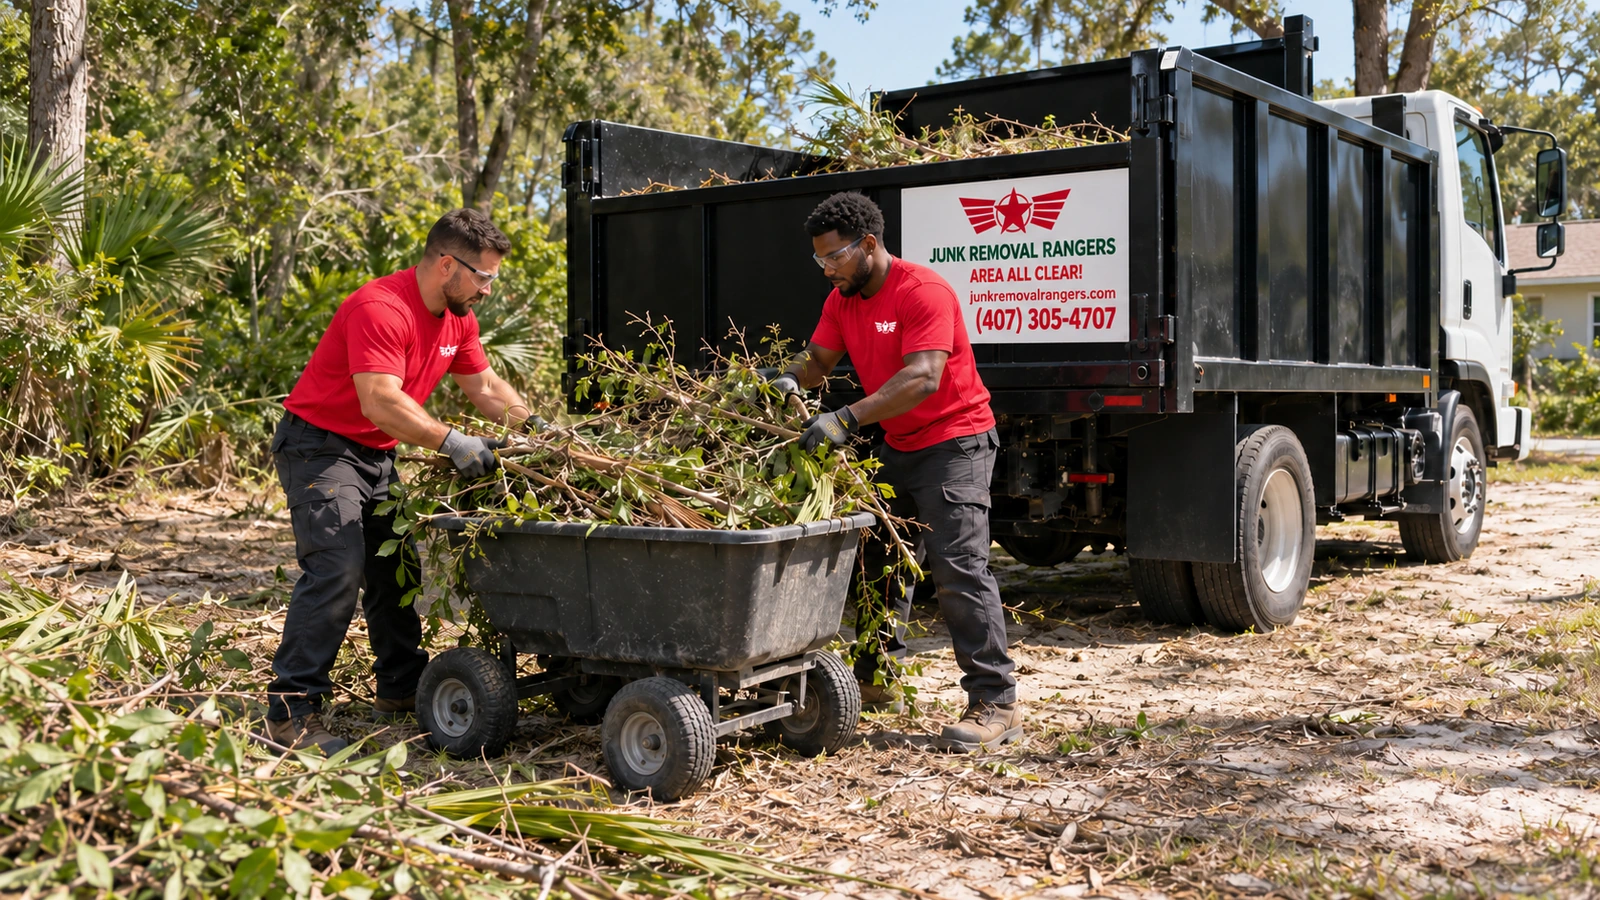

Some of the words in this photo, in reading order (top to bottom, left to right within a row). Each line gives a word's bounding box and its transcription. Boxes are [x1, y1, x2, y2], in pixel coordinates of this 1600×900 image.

[929, 246, 966, 263] JUNK
[970, 242, 1038, 262] REMOVAL
[1043, 237, 1117, 258] RANGERS
[970, 267, 1004, 283] AREA
[1007, 266, 1031, 282] ALL
[1035, 264, 1083, 281] CLEAR!
[969, 288, 1116, 306] junkremovalrangers.com
[976, 306, 1022, 334] (407)
[1028, 306, 1117, 331] 305-4707
